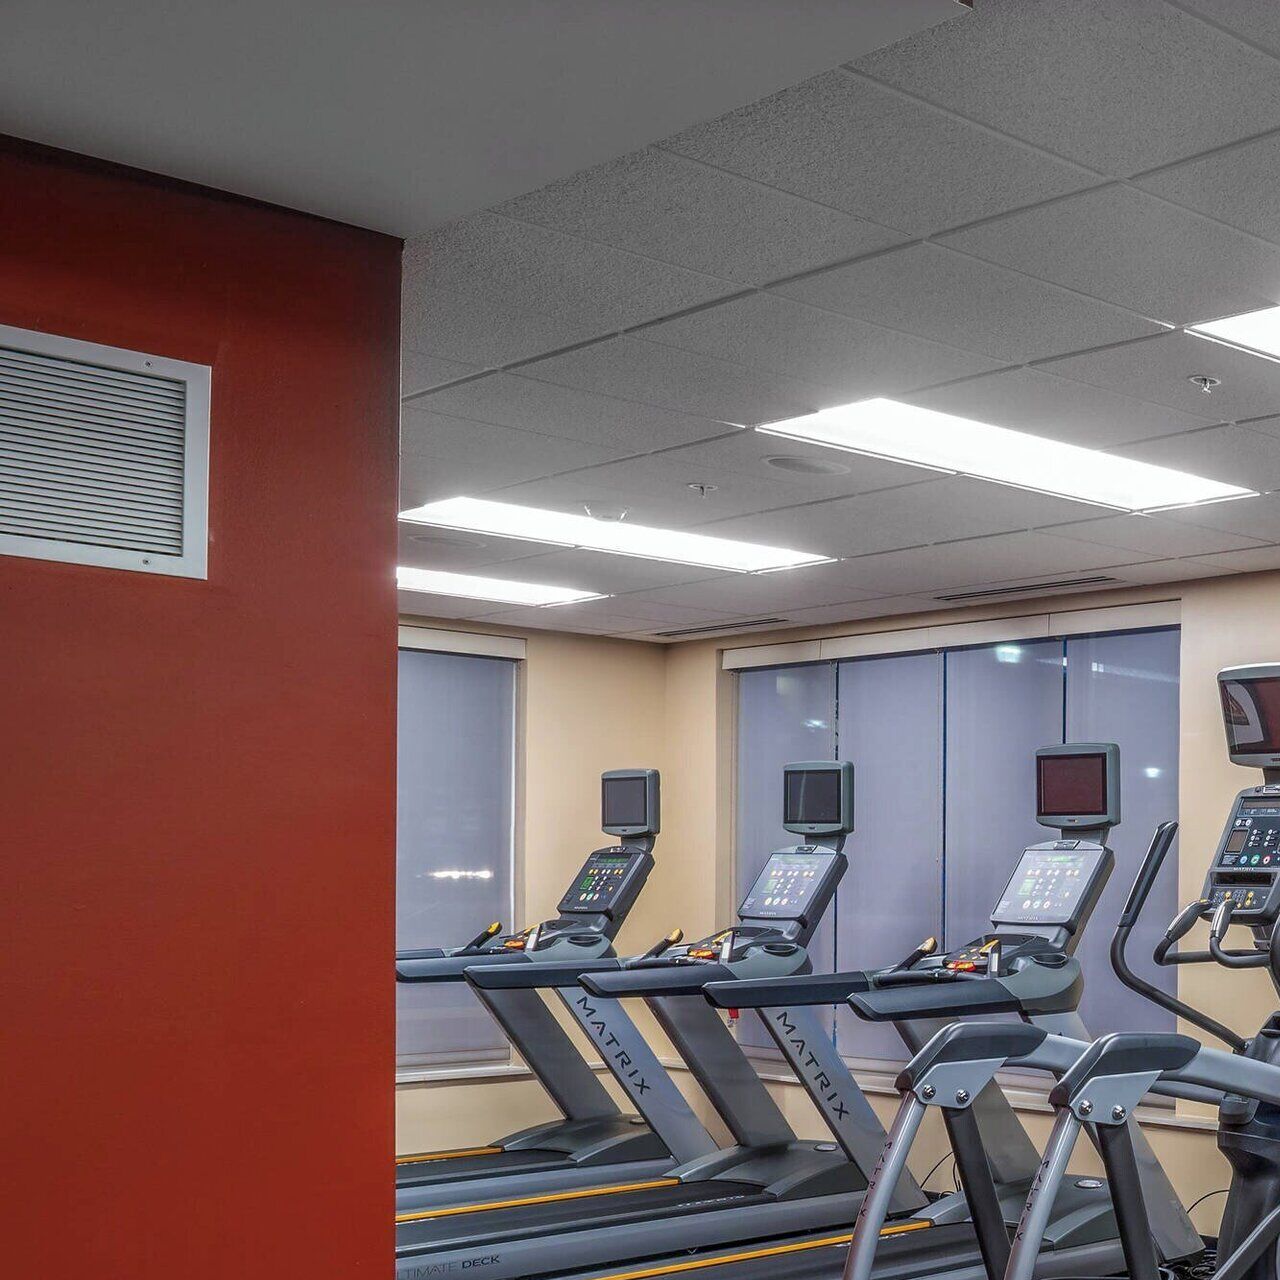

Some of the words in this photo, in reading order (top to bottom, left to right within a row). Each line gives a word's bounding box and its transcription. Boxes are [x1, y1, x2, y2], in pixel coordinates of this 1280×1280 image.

[576, 996, 651, 1096] MATRIX
[776, 1011, 850, 1121] MATRIX
[461, 1255, 501, 1270] DECK
